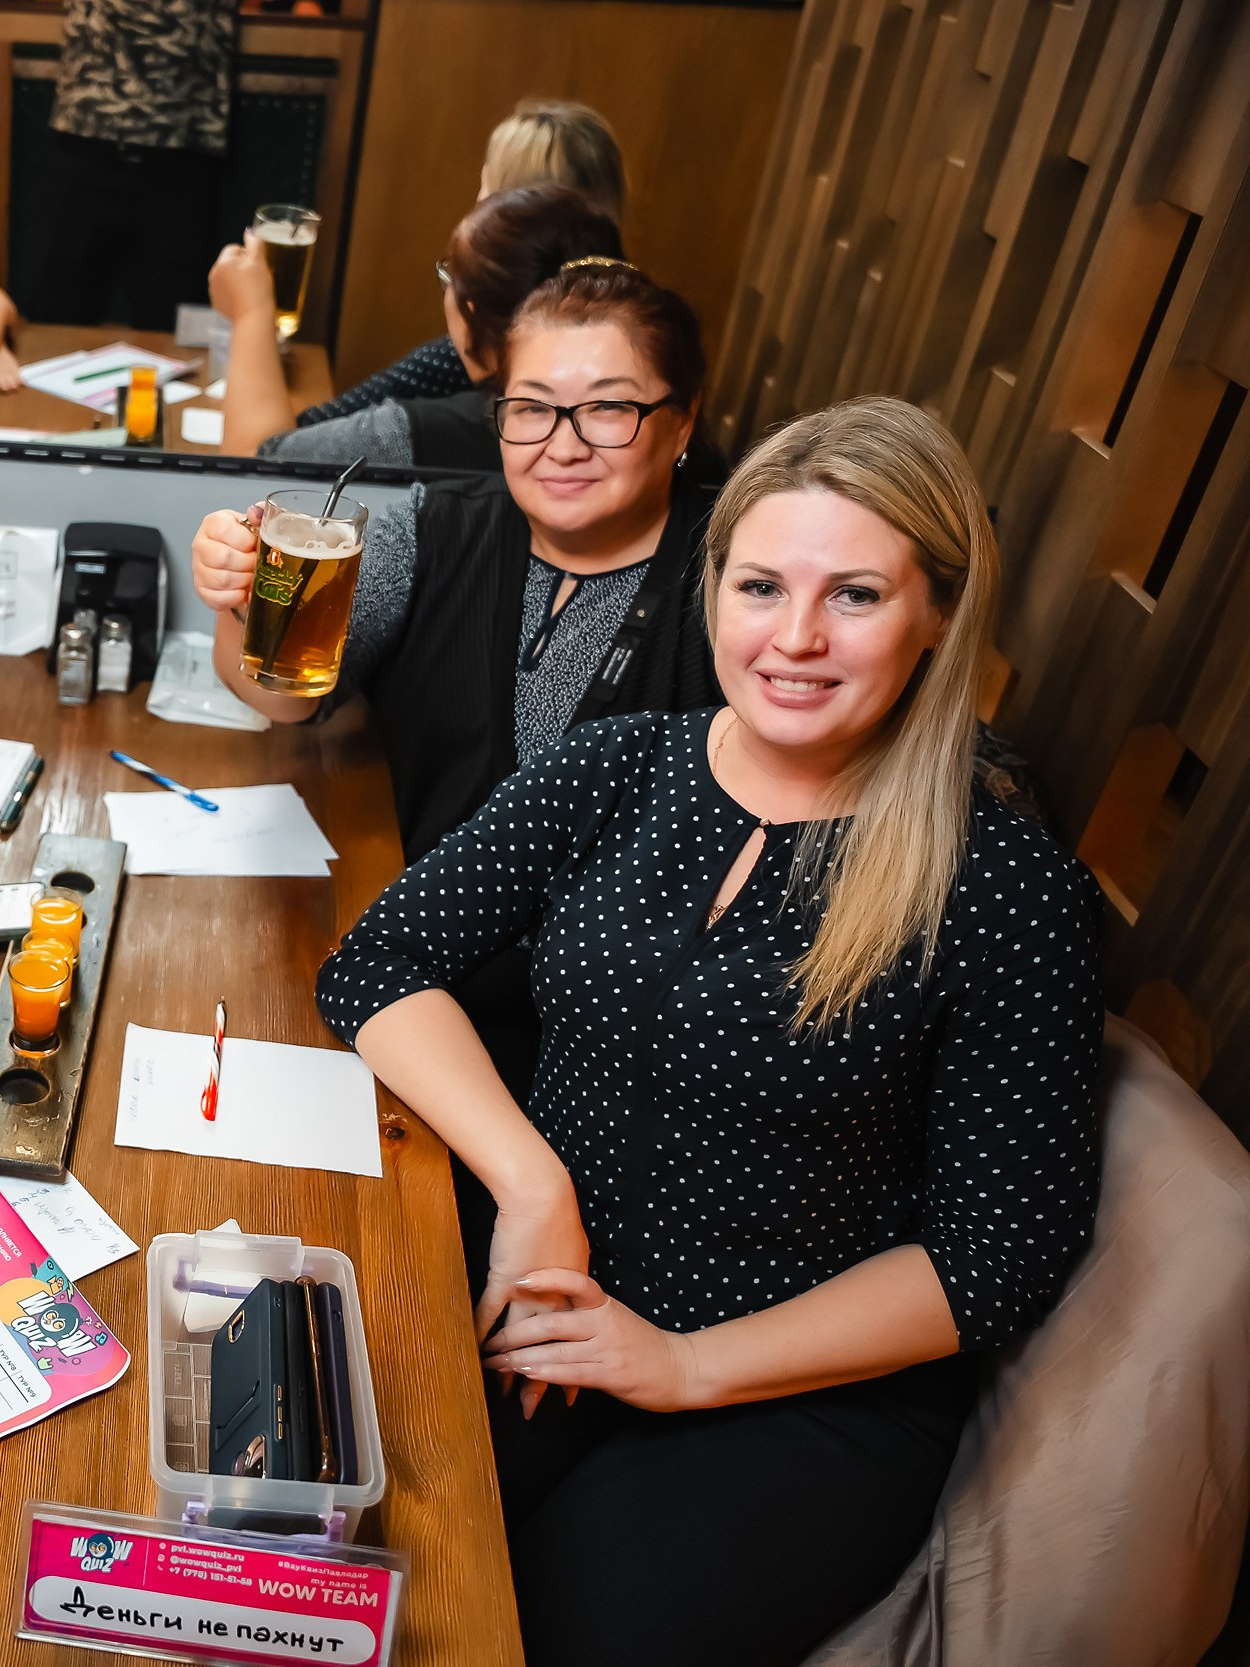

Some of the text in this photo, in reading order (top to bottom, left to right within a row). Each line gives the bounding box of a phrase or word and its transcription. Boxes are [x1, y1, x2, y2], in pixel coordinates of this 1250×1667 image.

[17, 1290, 98, 1358] WOW
[11, 1315, 58, 1354] QUIZ
[70, 1536, 134, 1561] WOW
[170, 1544, 245, 1562] pvl.wowquiz.ru
[80, 1556, 115, 1573] QUIZ
[169, 1555, 242, 1573] @wowquiz_pvl
[169, 1566, 181, 1574] +7
[277, 1560, 369, 1579] #ВауКвизПавлодар
[258, 1577, 379, 1607] WOW TEAM
[310, 1578, 326, 1587] my
[329, 1580, 357, 1588] name
[59, 1585, 345, 1653] Деньги не пахнут
